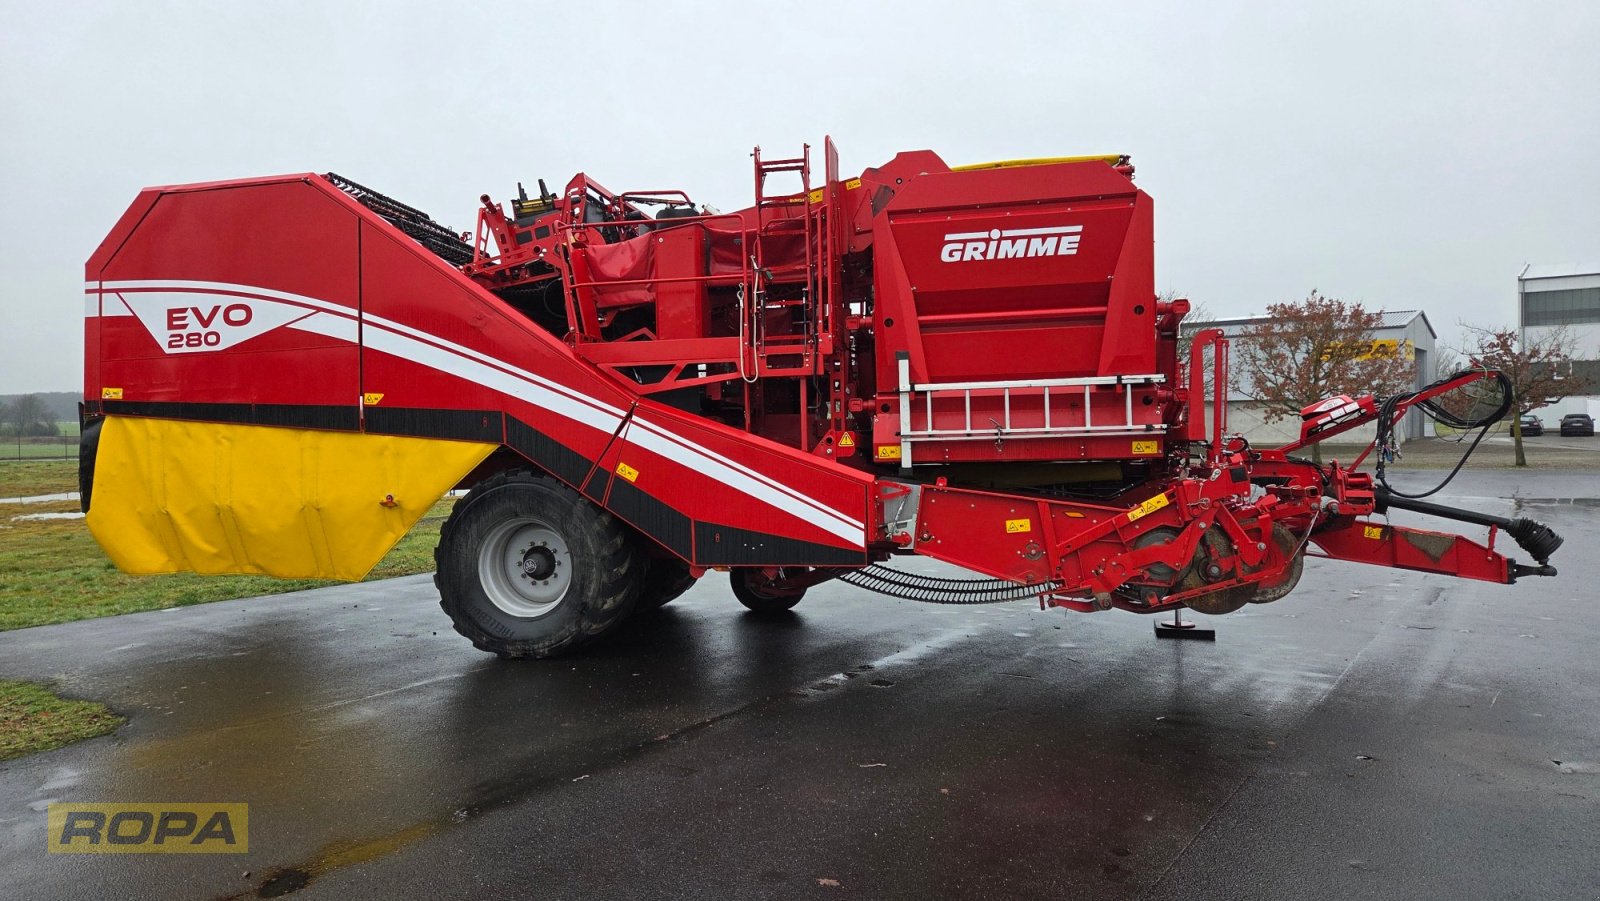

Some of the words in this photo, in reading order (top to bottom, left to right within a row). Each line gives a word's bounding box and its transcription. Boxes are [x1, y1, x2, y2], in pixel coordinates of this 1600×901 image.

[940, 227, 1081, 263] GRIMME
[167, 303, 253, 330] EVO
[167, 331, 221, 349] 280
